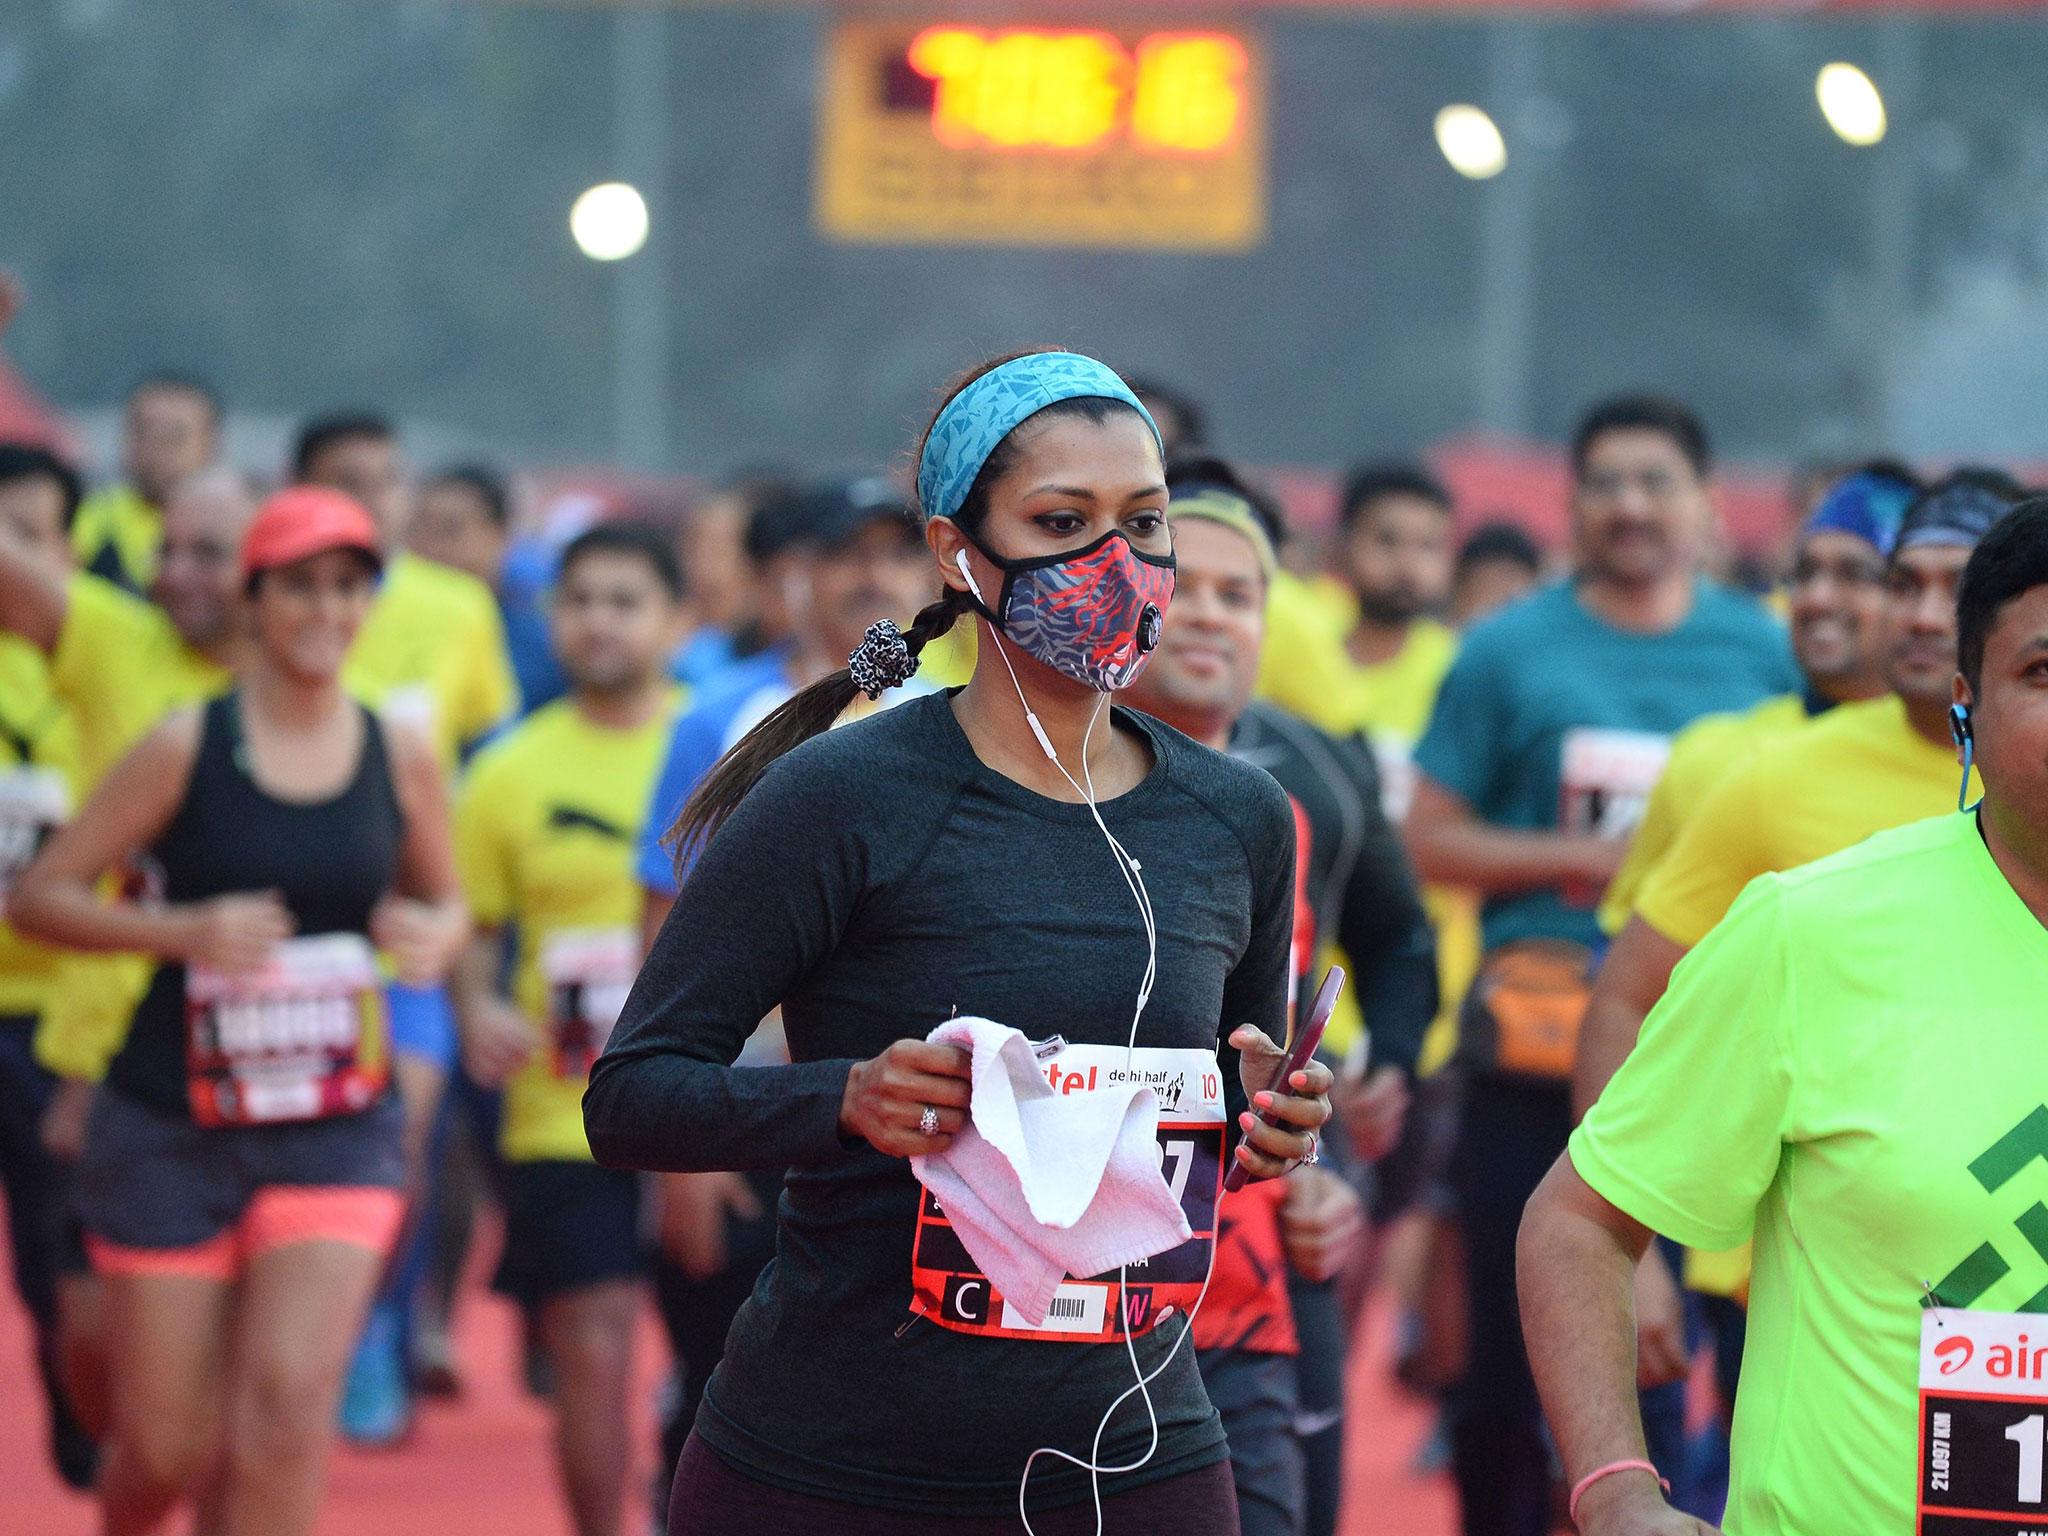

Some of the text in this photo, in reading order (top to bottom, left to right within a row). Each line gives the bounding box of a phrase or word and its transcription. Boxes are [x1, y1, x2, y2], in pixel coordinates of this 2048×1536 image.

[1043, 1063, 1098, 1096] tel
[1109, 1069, 1168, 1083] dehi half
[1202, 1073, 1217, 1100] 10
[1155, 1140, 1195, 1204] 7
[955, 1281, 981, 1320] C
[1931, 1411, 1951, 1492] 21.097 KM
[2005, 1413, 2048, 1504] 1
